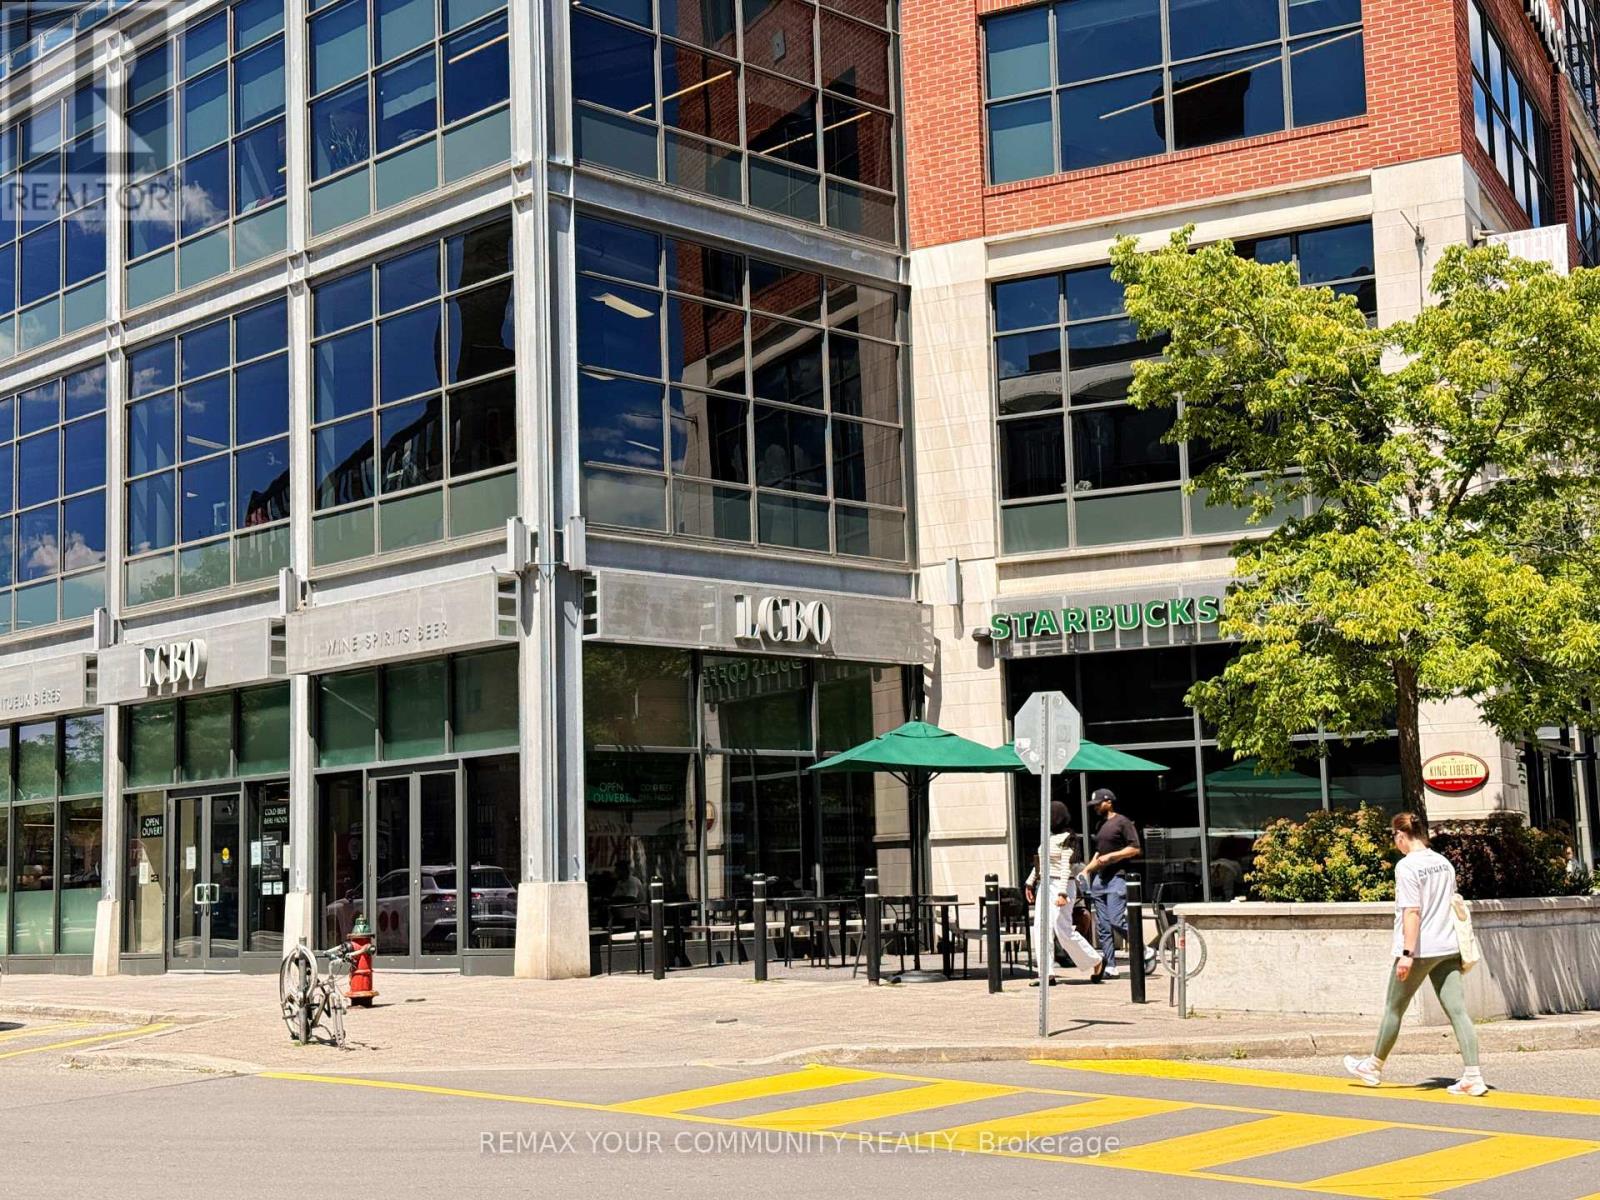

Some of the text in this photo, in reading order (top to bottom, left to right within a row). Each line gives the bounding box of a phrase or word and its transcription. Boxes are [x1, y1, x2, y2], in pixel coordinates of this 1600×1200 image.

[734, 594, 831, 645] LCBO
[990, 596, 1220, 640] STARBUCKS
[326, 621, 448, 656] WINE SPIRITS BEER
[139, 638, 208, 689] LCBO
[1429, 763, 1478, 777] KING LIBERTY
[142, 826, 163, 837] OUVERT
[145, 817, 160, 827] OPEN
